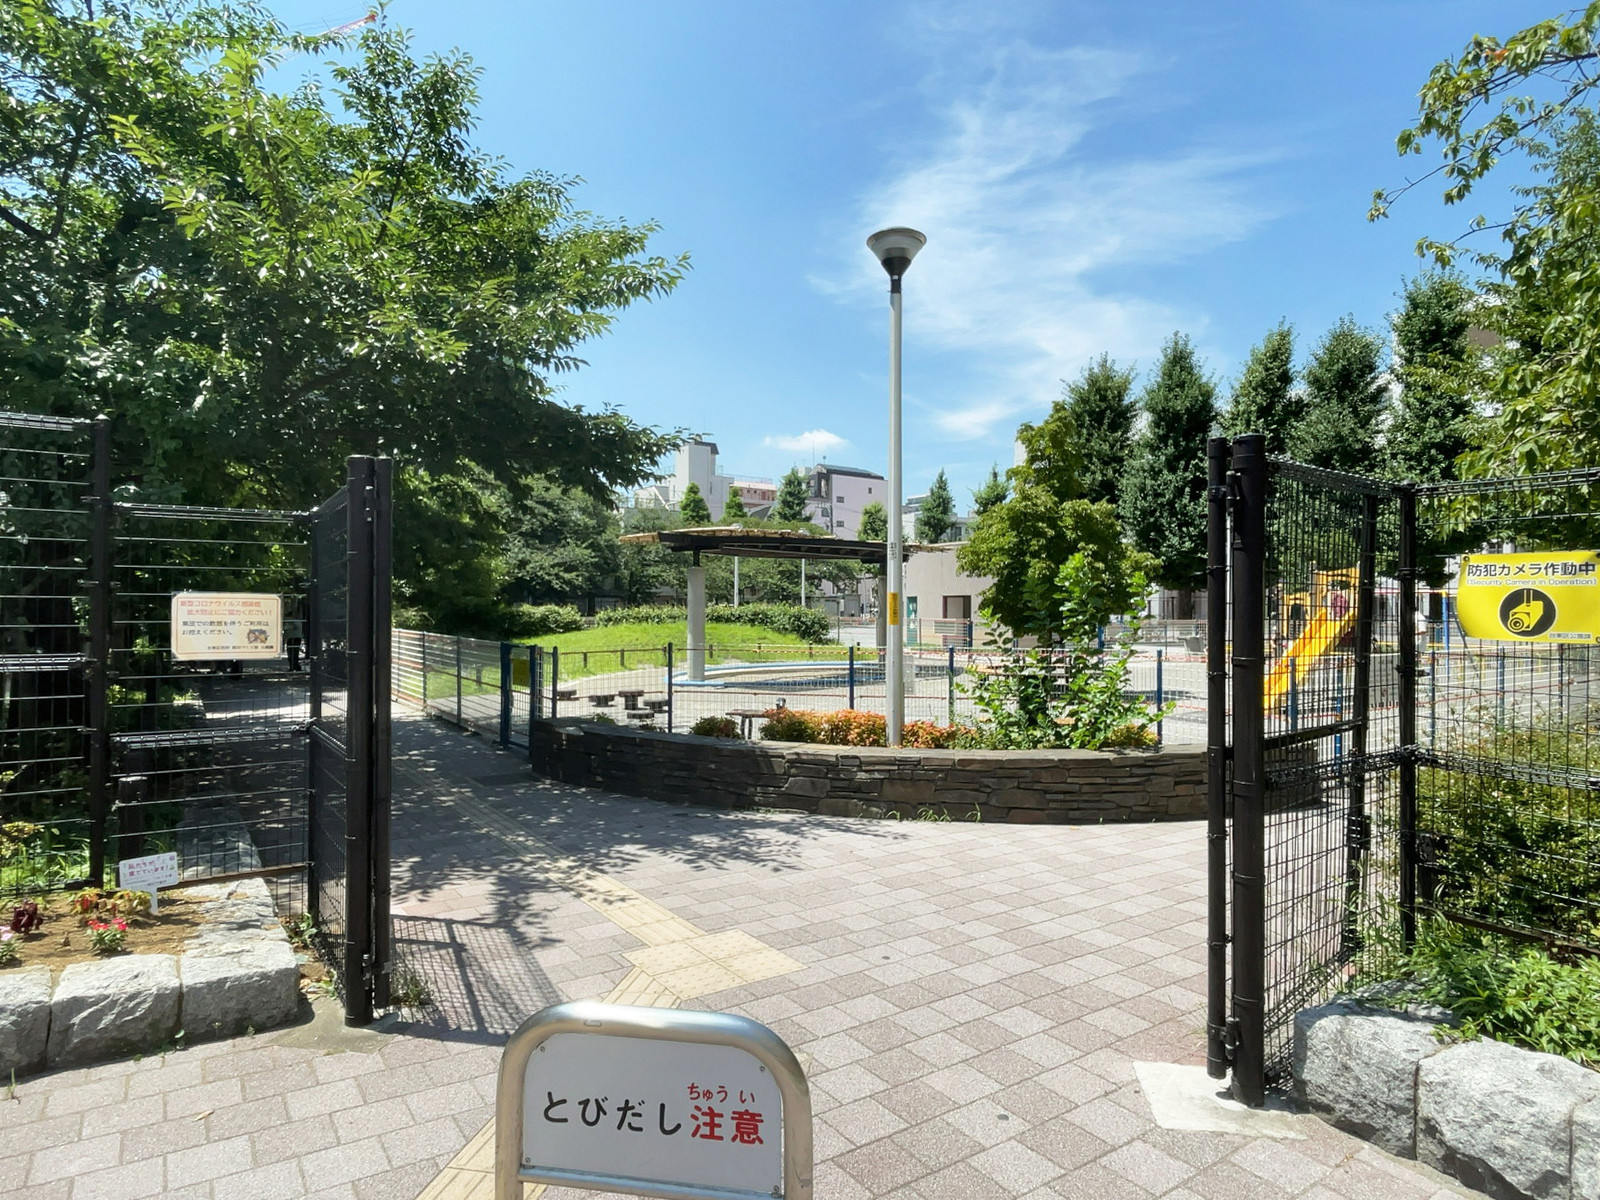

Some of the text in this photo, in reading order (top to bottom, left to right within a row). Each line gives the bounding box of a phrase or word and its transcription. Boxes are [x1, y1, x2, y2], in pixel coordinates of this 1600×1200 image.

[1467, 562, 1595, 577] 防犯カメラ作動中
[1549, 578, 1597, 586] Operation)
[687, 1082, 755, 1104] ちゅうい
[543, 1090, 764, 1145] とびだし注意
